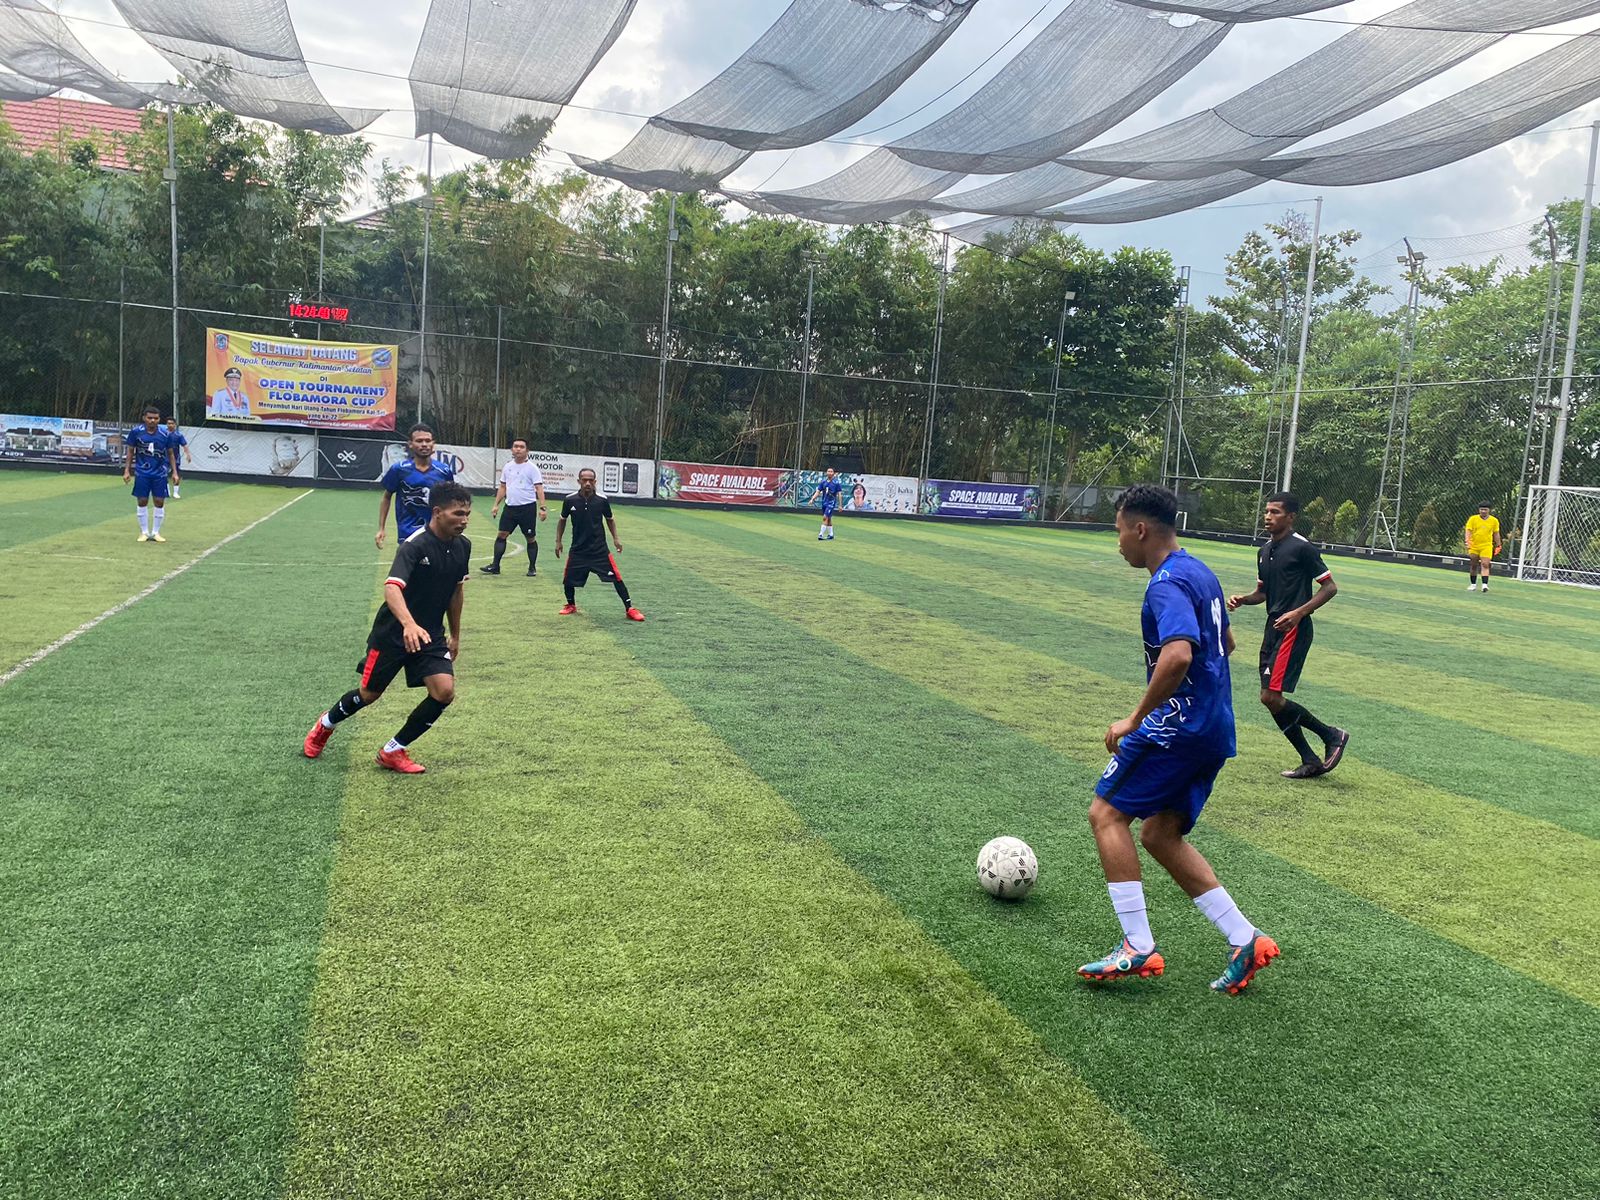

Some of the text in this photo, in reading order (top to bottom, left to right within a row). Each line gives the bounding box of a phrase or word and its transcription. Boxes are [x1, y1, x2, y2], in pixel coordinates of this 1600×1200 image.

[251, 341, 358, 361] SELAMAT DATANG
[234, 355, 372, 374] Bapak Gubernur Kalimantan Selatan
[259, 379, 385, 396] OPEN TOURNAMENT
[269, 391, 376, 407] FLOBAMORA CUP
[258, 401, 291, 410] Menyambut
[304, 404, 320, 413] Ulang
[337, 407, 366, 415] Flobamora
[527, 453, 559, 462] WROOM
[536, 463, 564, 471] MOTOR
[689, 472, 768, 490] SPACE AVAILABLE
[948, 489, 1019, 505] SPACE AVAILABLE
